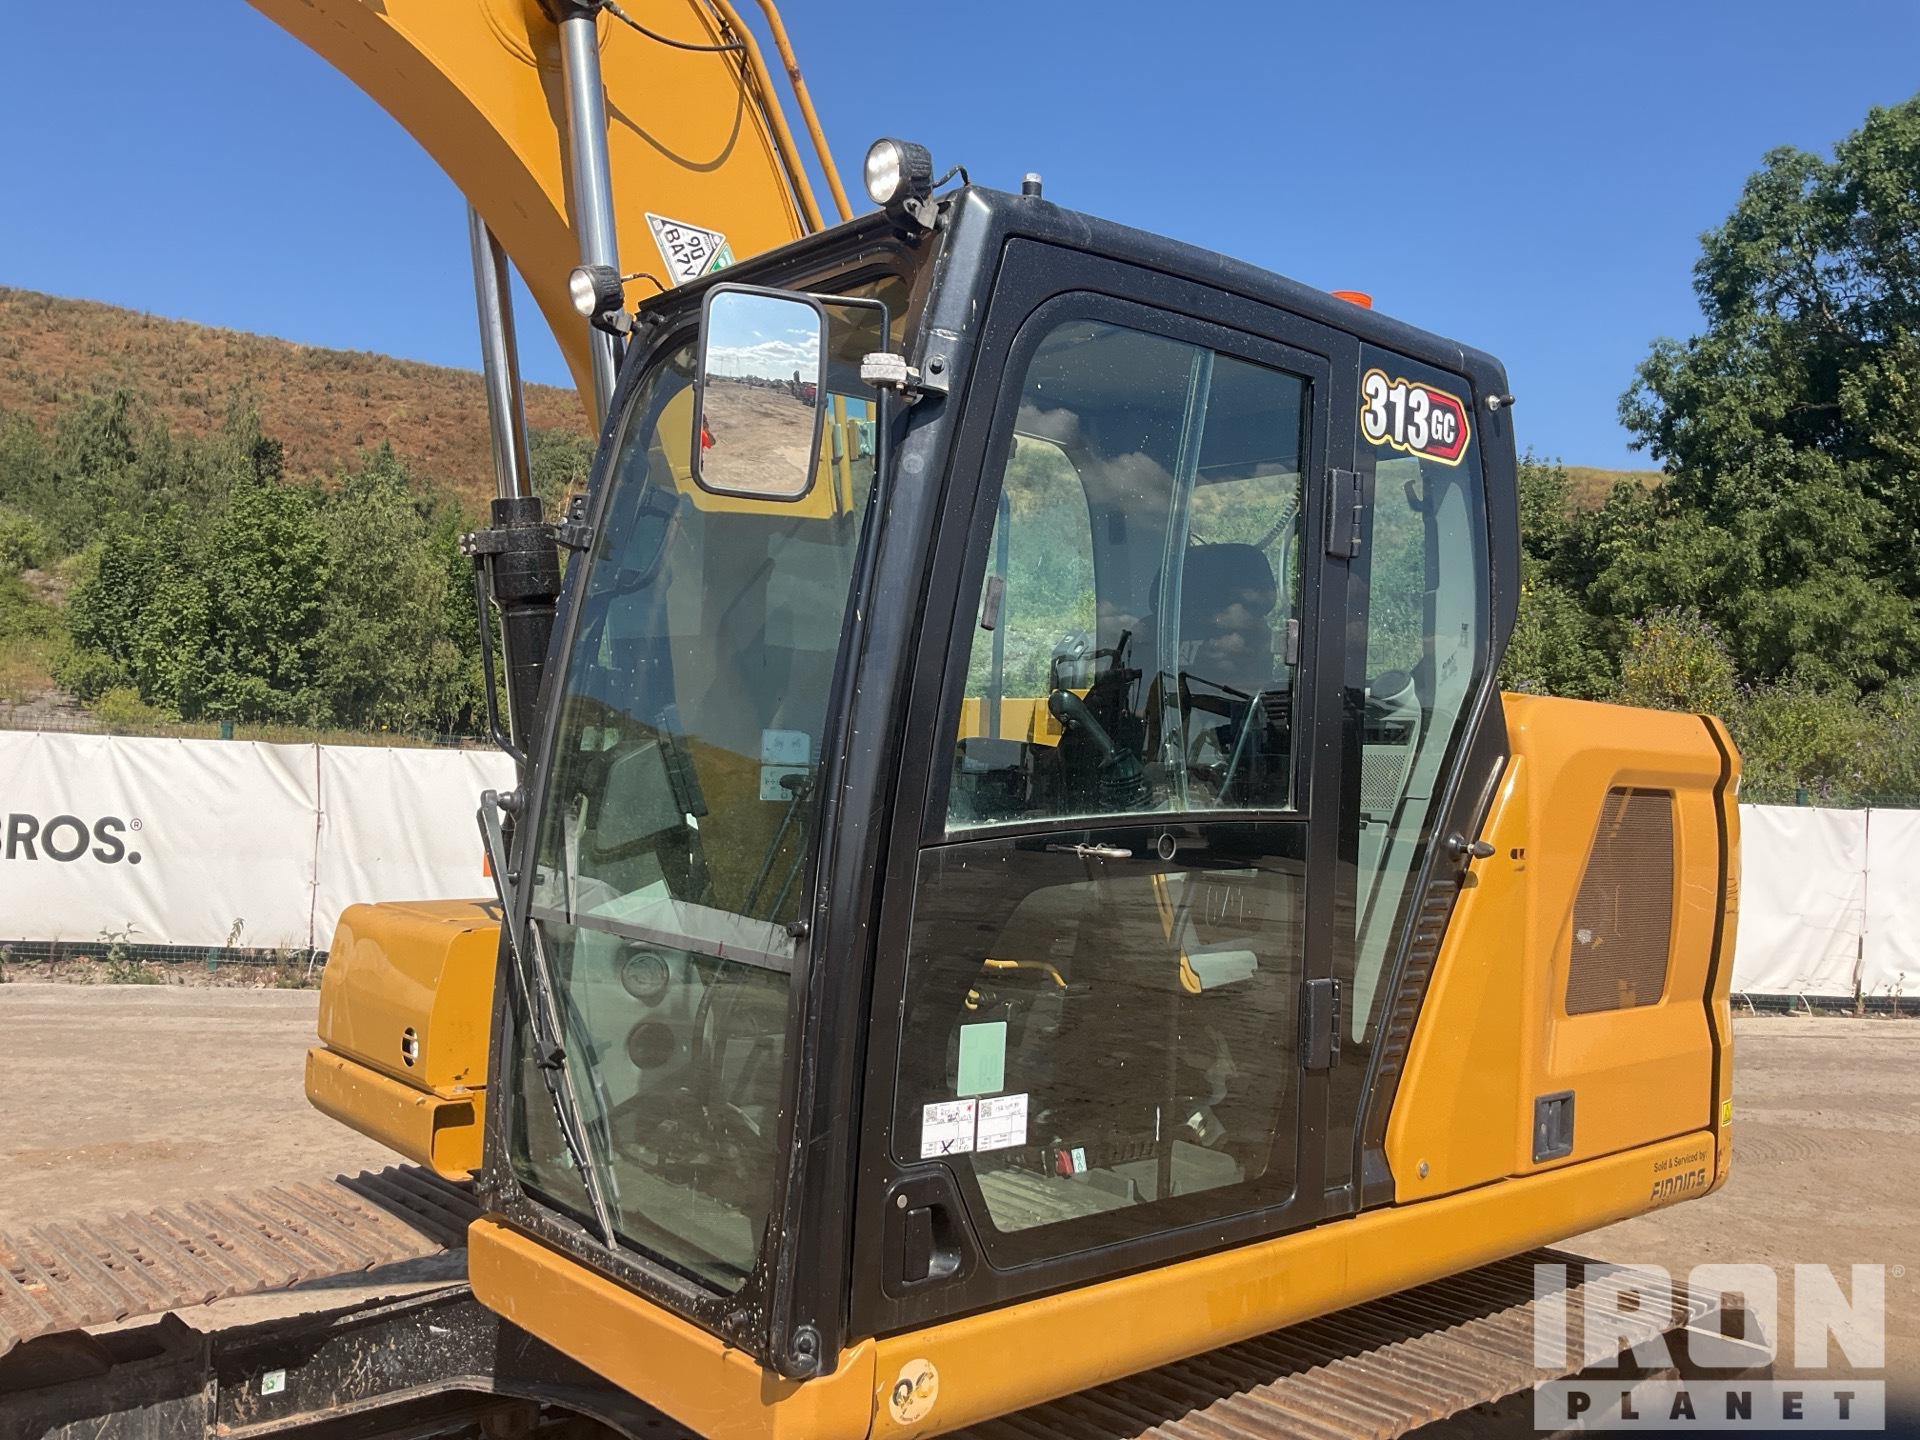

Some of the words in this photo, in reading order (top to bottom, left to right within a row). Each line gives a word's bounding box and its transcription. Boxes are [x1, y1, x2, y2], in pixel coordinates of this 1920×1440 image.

[1365, 374, 1430, 449] 313
[1431, 409, 1456, 444] GC
[0, 813, 142, 865] ROS.
[1653, 1160, 1668, 1173] Sold
[1668, 1159, 1673, 1169] &
[1674, 1152, 1699, 1167] Serviced
[1699, 1150, 1708, 1161] by:
